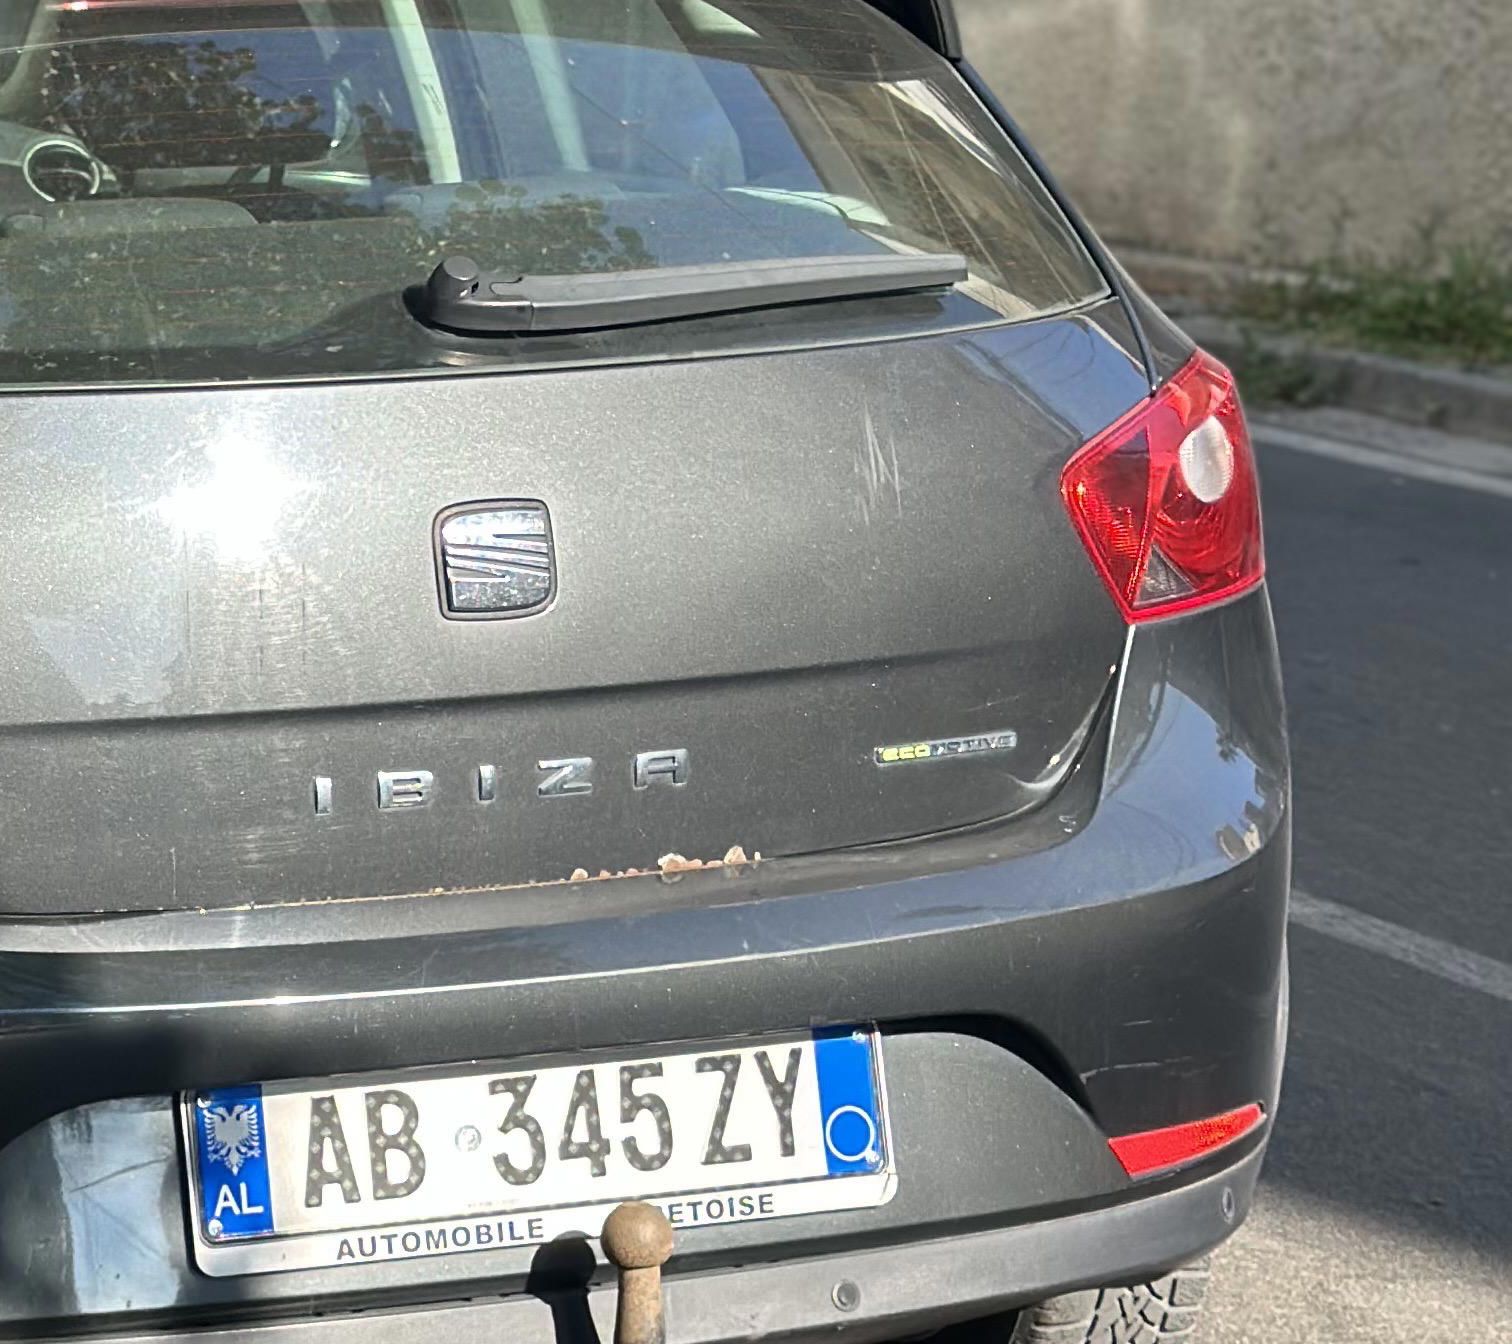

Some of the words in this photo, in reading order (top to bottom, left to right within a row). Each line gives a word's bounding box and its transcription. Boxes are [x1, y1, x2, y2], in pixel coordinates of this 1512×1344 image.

[313, 748, 689, 815] IBIZA
[304, 1089, 426, 1208] AB
[214, 1181, 265, 1217] AL
[336, 1217, 545, 1261] AUTOMOBILE
[658, 1193, 775, 1224] ETOISE
